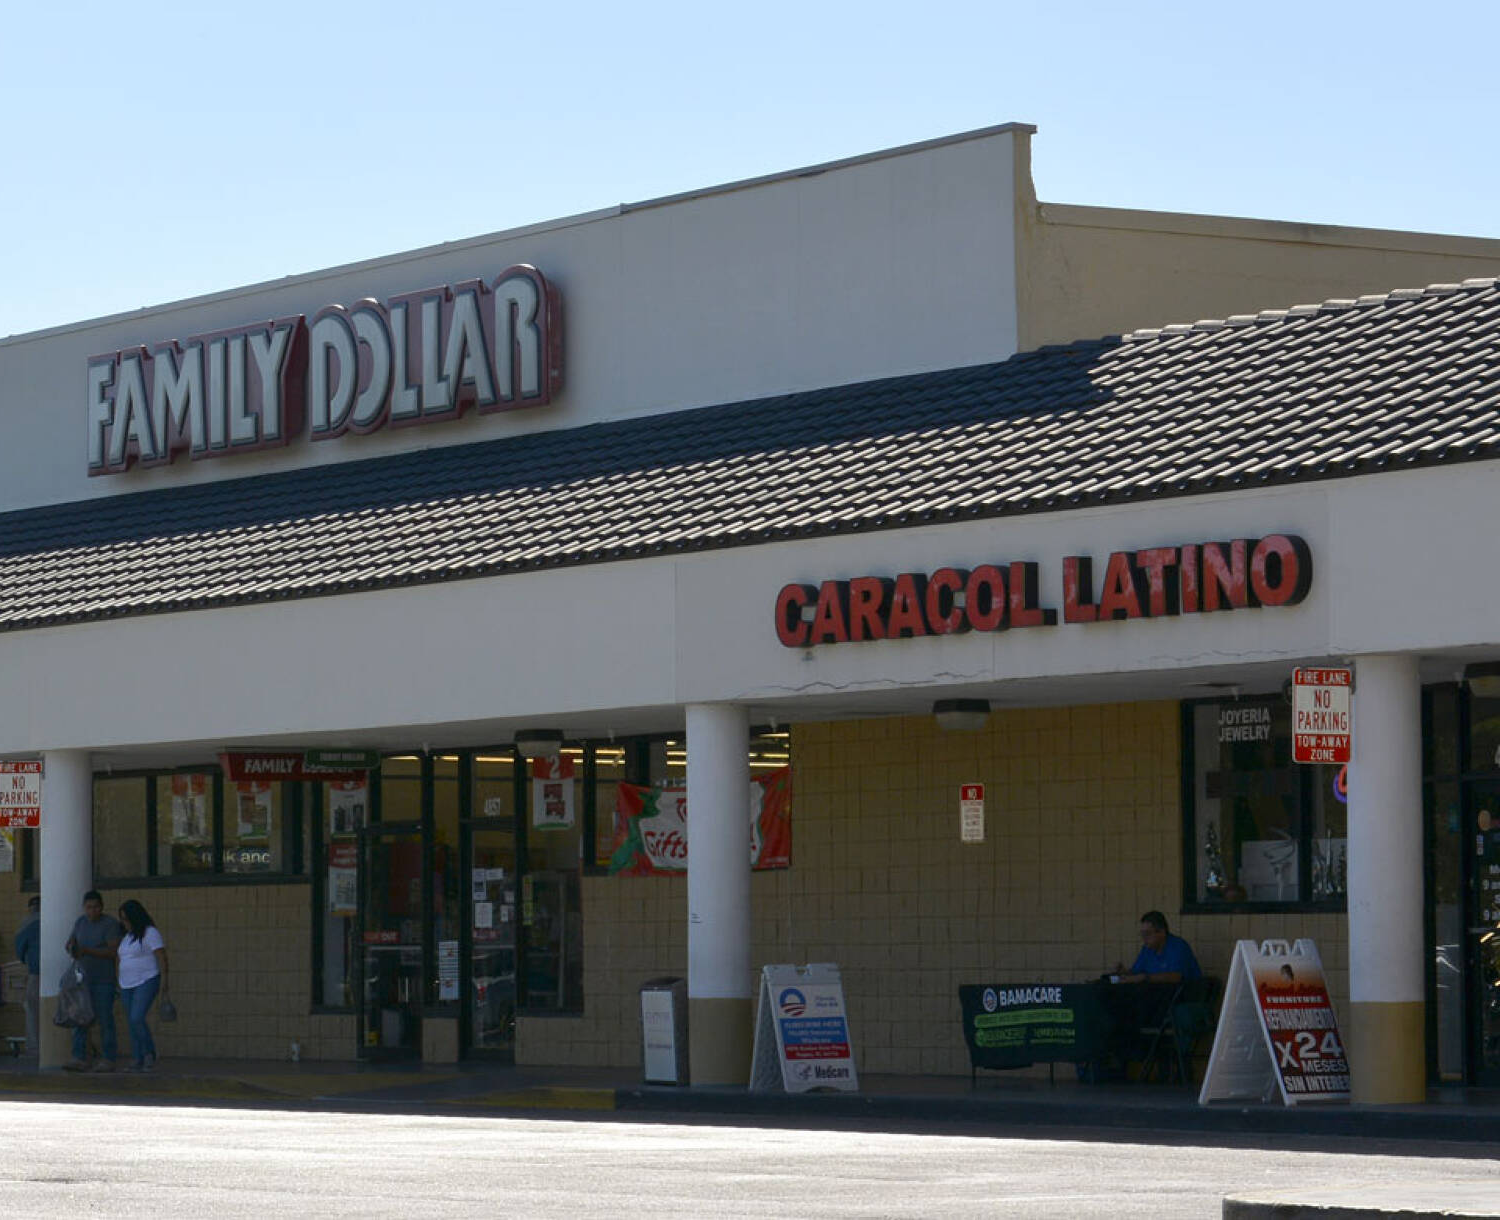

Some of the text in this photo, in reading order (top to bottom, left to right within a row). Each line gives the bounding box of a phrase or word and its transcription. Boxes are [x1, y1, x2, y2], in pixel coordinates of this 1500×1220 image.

[88, 264, 552, 475] FAMILY DOLLAR
[775, 534, 1312, 647] CARACOL LATINO
[1297, 671, 1347, 684] FIRE LANE
[1314, 689, 1331, 709] NO
[1218, 707, 1271, 724] JOYERIA
[1298, 711, 1348, 731] PARKING
[1218, 724, 1271, 742] JEWELRY
[1298, 735, 1348, 748] TOW-AWAY
[1311, 749, 1335, 760] ZONE
[0, 763, 39, 773] FIRE LANE
[244, 758, 297, 774] FAMILY
[12, 776, 26, 790] NO
[0, 791, 38, 805] PARKING
[0, 808, 38, 817] TOW-AWAY
[1295, 1031, 1342, 1059] 24
[815, 1065, 850, 1079] Medicare
[1301, 1060, 1348, 1073] MESES
[1284, 1075, 1308, 1092] SIN
